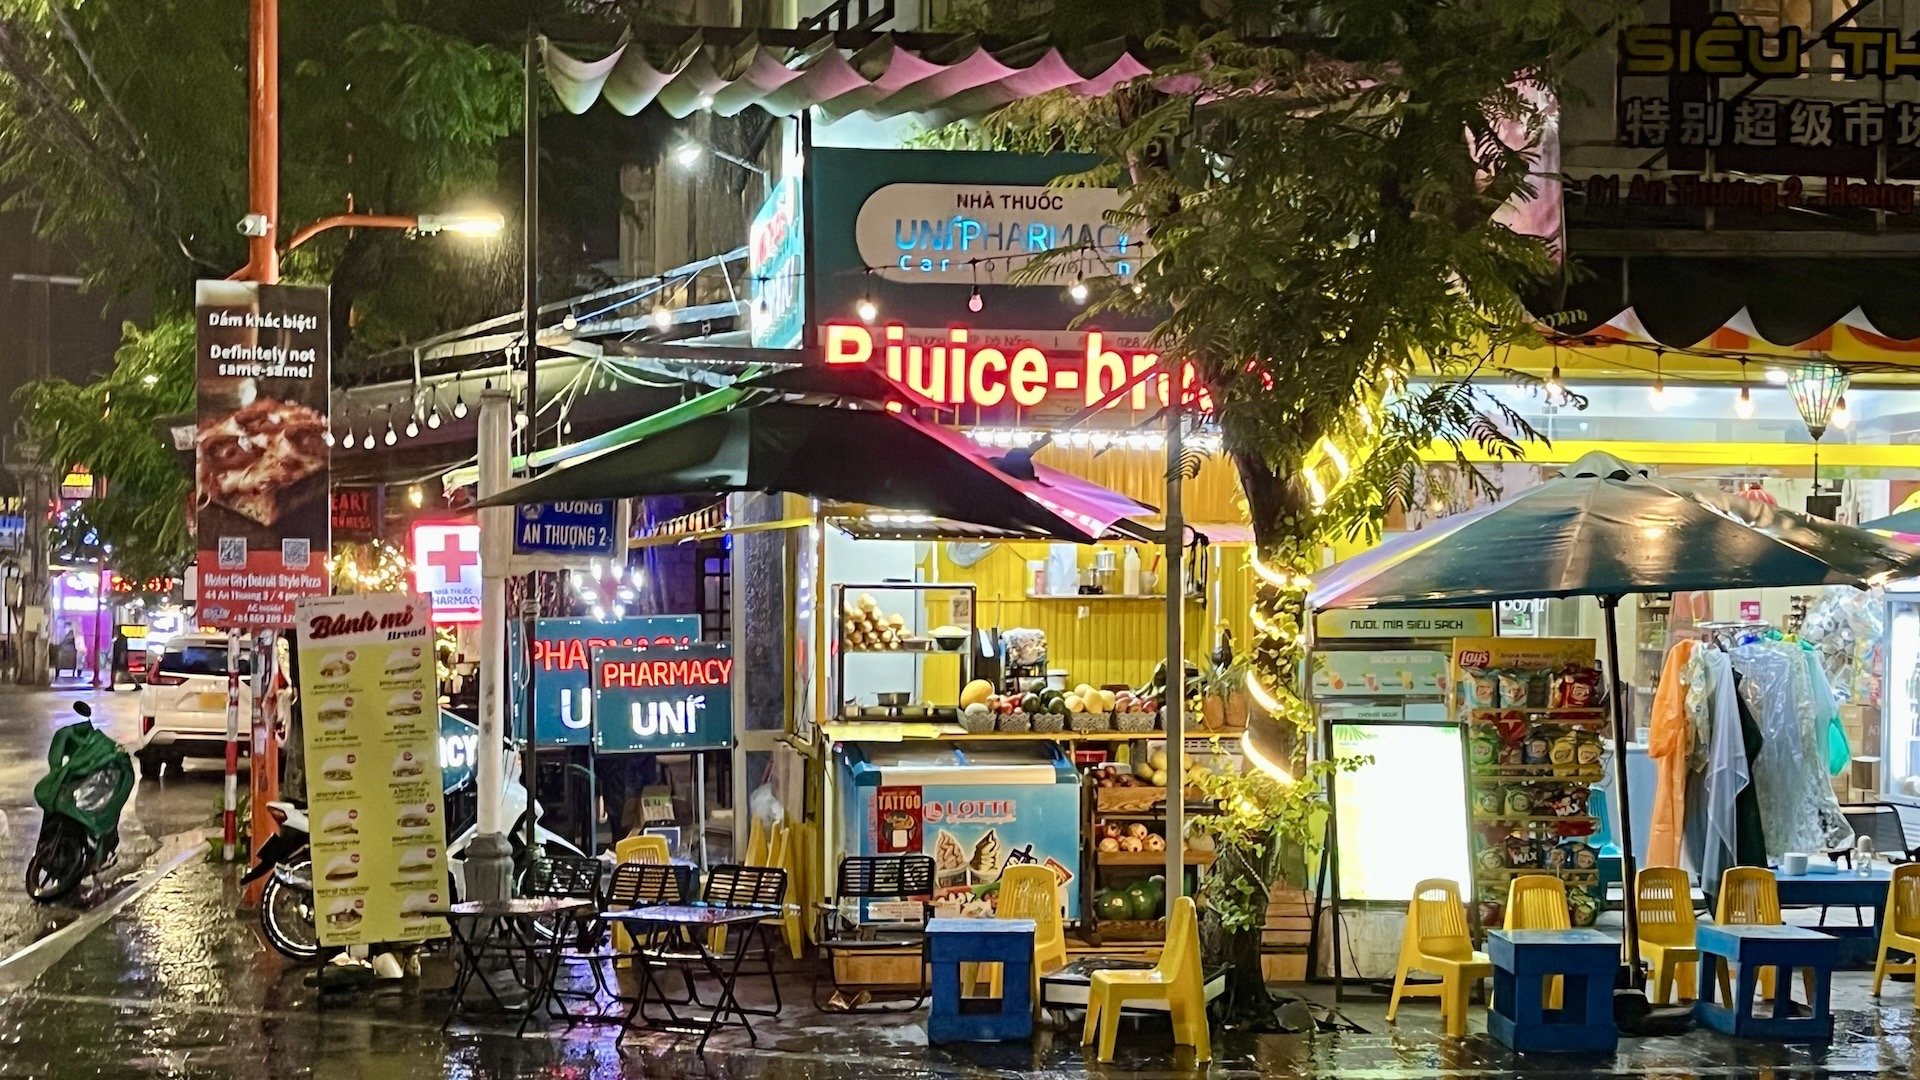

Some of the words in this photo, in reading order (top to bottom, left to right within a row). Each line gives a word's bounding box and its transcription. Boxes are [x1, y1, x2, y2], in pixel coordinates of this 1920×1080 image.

[1626, 15, 1798, 75] SIÊU
[1629, 174, 1668, 203] An
[957, 190, 995, 210] NHÀ
[1000, 191, 1064, 210] THUỐC
[209, 309, 243, 327] Dám
[245, 311, 281, 328] khác
[210, 344, 288, 366] Definitely
[289, 348, 316, 362] not
[218, 363, 314, 378] same-same!
[331, 492, 369, 512] EART
[523, 523, 541, 544] AN
[545, 524, 596, 549] THƯỢNG
[599, 526, 607, 547] 2
[433, 595, 482, 605] HARMACY
[309, 610, 378, 639] Bánh
[1460, 651, 1489, 667] Lay's
[602, 658, 733, 688] PHARMACY
[878, 794, 922, 810] TATTOO
[1513, 851, 1538, 865] MAX
